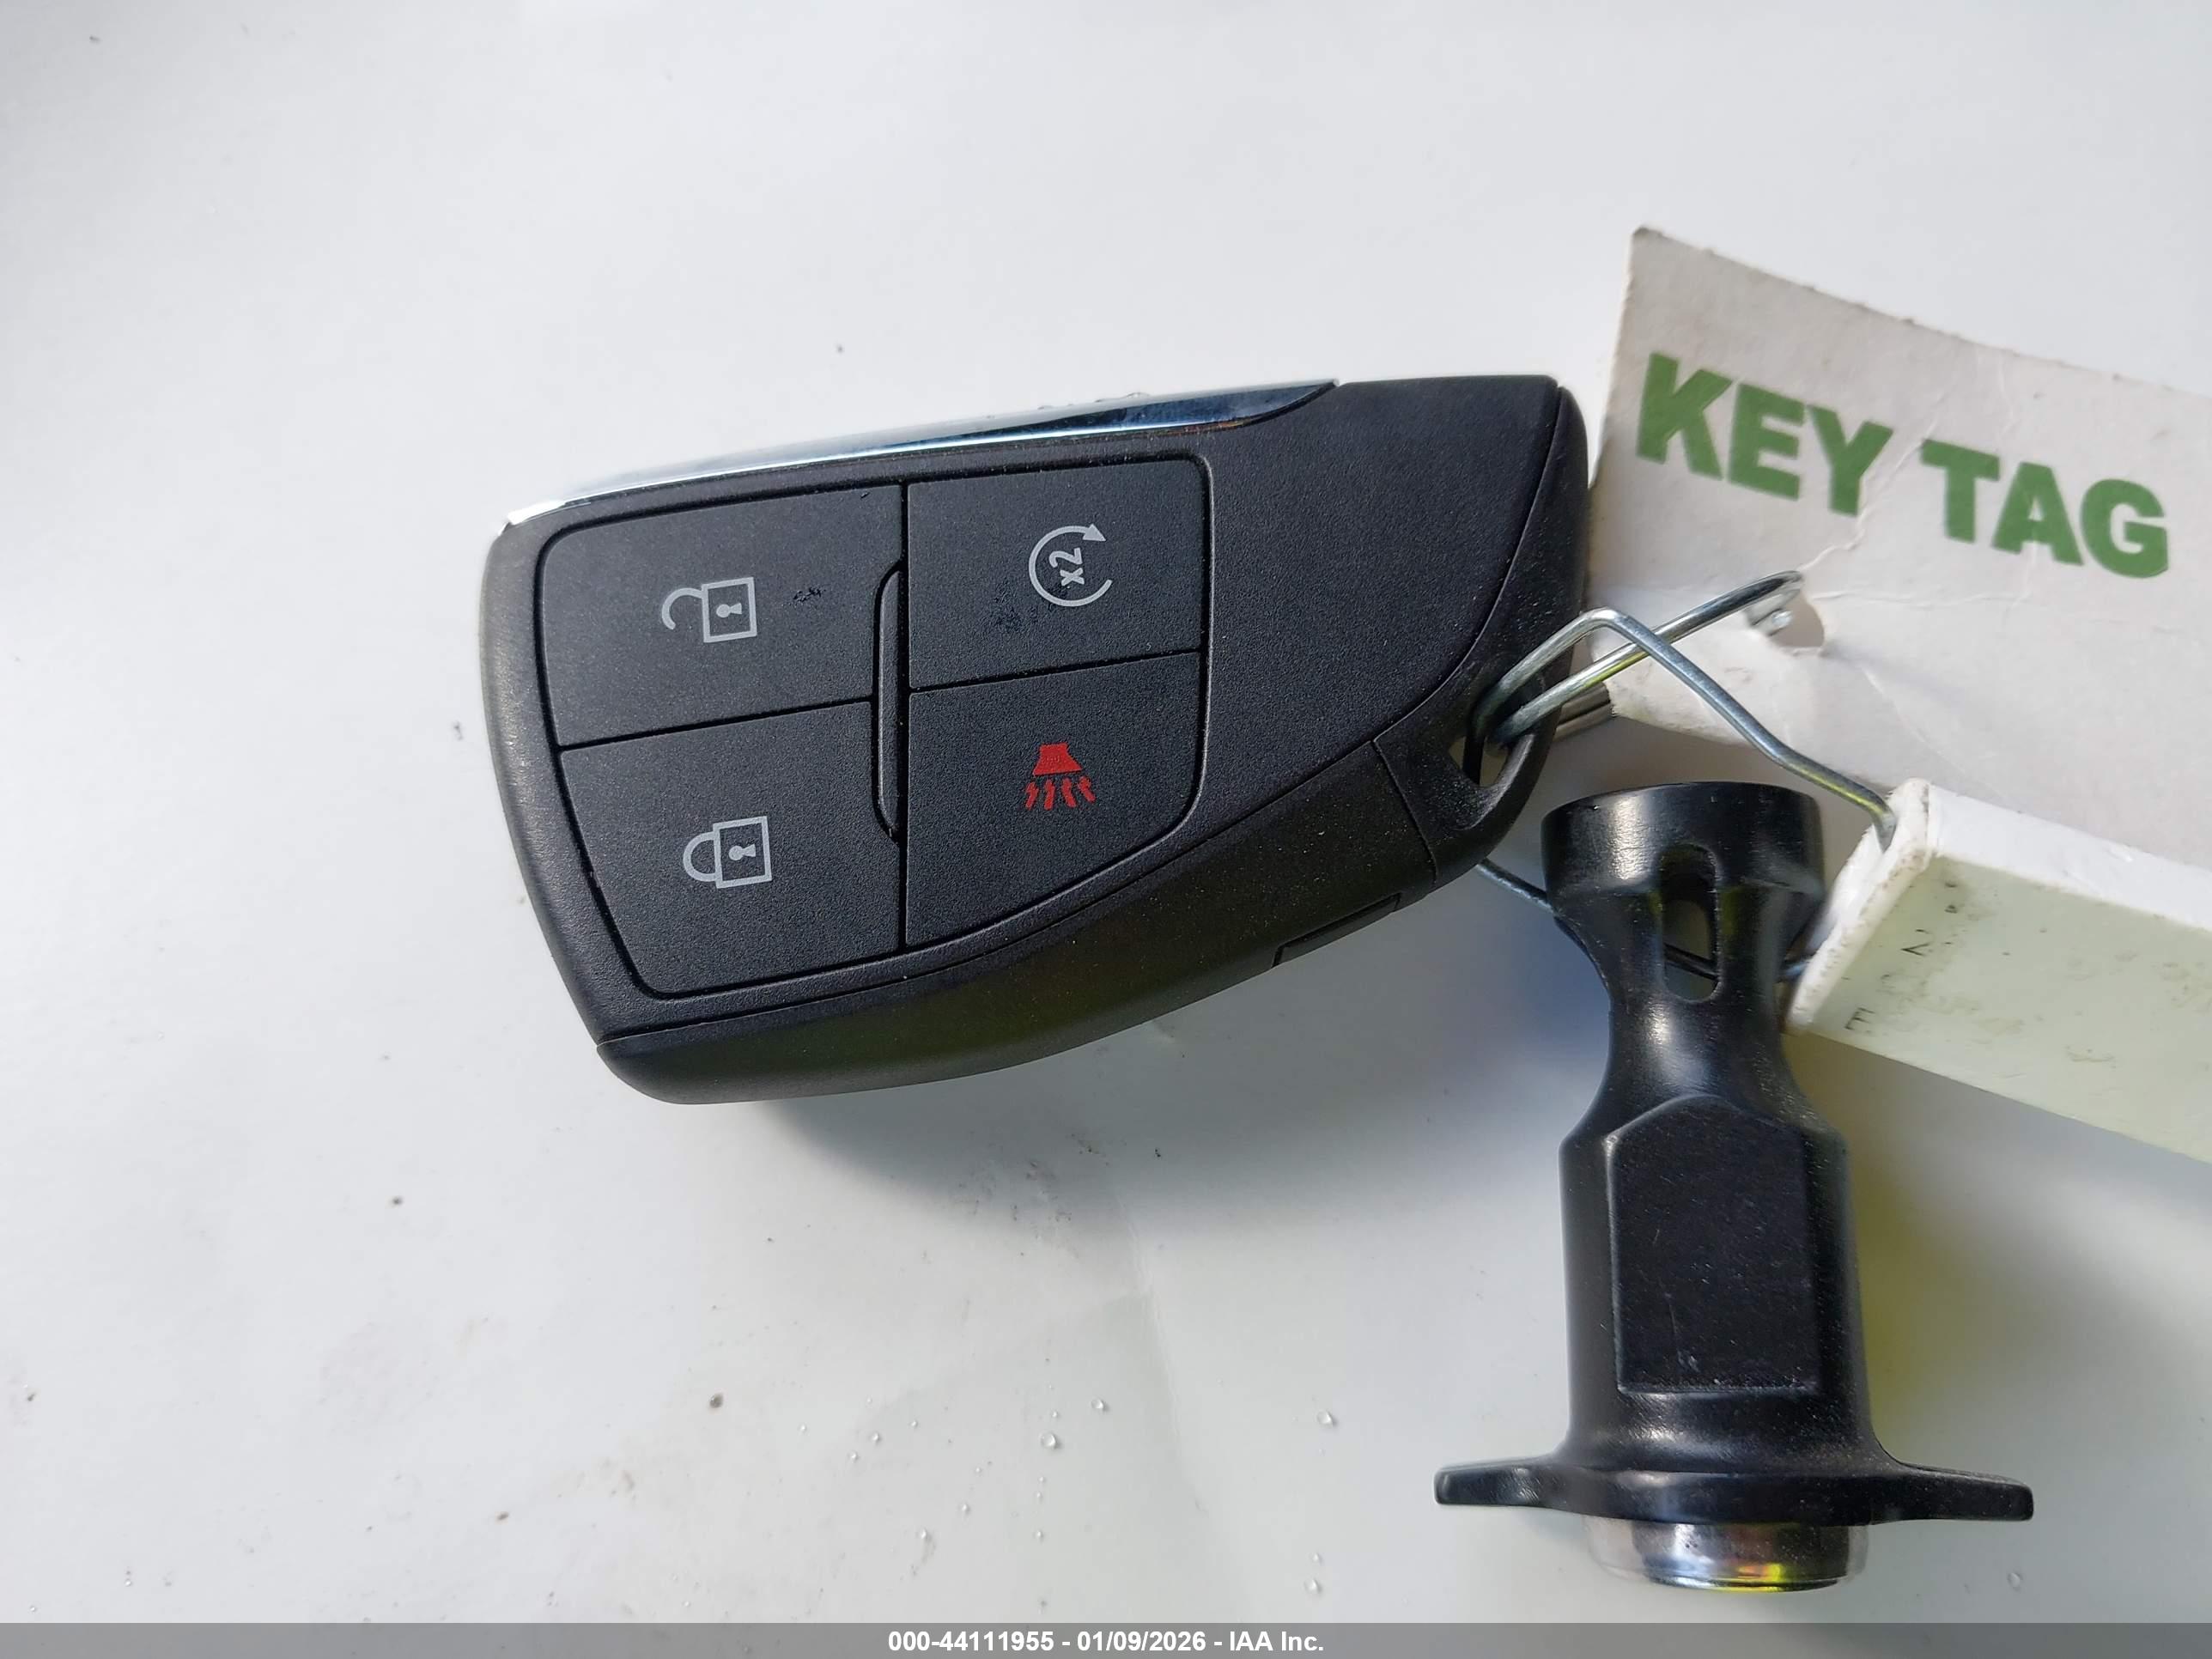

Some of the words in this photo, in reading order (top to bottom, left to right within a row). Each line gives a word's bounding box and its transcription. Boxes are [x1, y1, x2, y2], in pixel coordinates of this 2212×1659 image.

[1636, 352, 1893, 517] KEY
[1920, 439, 2169, 579] TAG
[1048, 547, 1085, 586] x2
